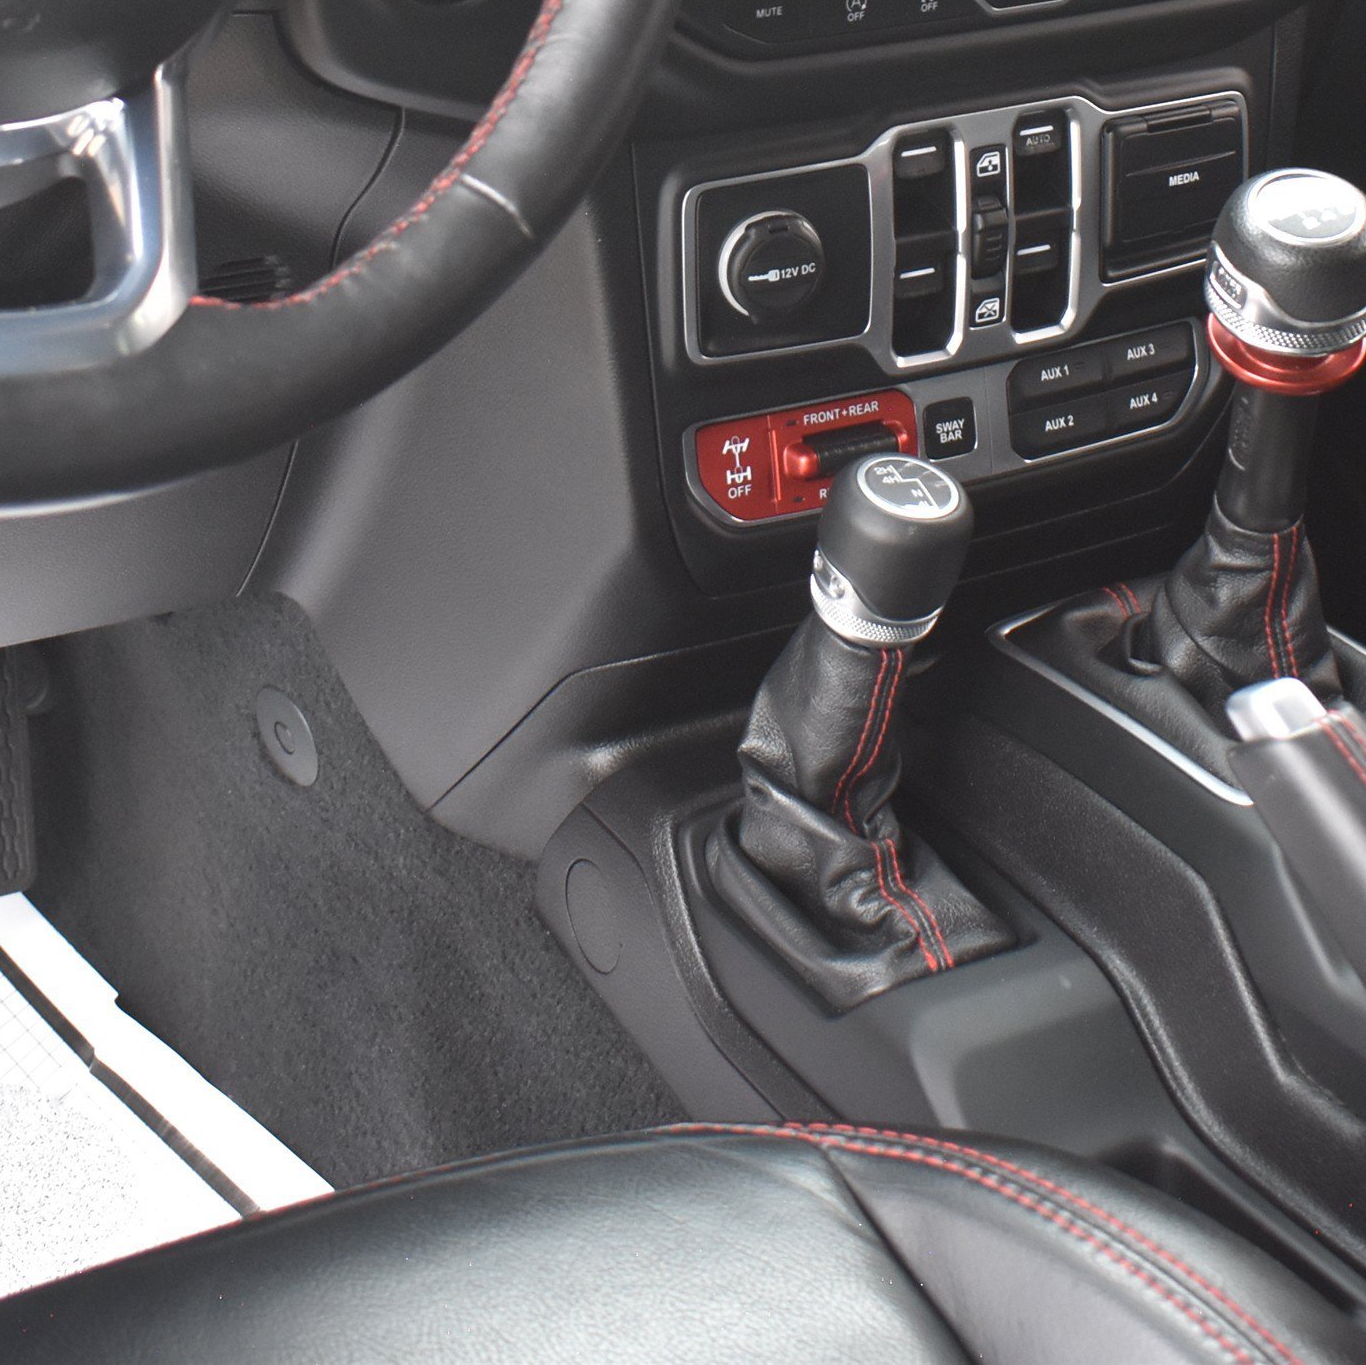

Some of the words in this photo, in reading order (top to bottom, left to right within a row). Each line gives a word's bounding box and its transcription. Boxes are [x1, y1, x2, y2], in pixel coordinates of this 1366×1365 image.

[756, 6, 783, 19] MUTE
[921, 2, 938, 13] OFF
[847, 11, 865, 22] OFF
[1025, 134, 1051, 147] AUTO
[1168, 170, 1200, 187] MEDIA
[780, 266, 799, 279] 12V
[801, 262, 816, 275] DC
[1126, 345, 1147, 360] AUX
[1148, 343, 1155, 355] 3
[1040, 366, 1062, 381] AUX
[1063, 365, 1069, 376] 1
[1129, 394, 1151, 409] AUX
[1151, 392, 1158, 403] 4
[936, 418, 965, 434] SWAY
[1045, 416, 1067, 432] AUX
[1067, 415, 1074, 426] 2
[940, 430, 963, 443] BAR
[873, 465, 892, 475] 2H
[882, 475, 899, 484] 4H
[728, 485, 752, 499] OFF
[911, 489, 924, 498] N
